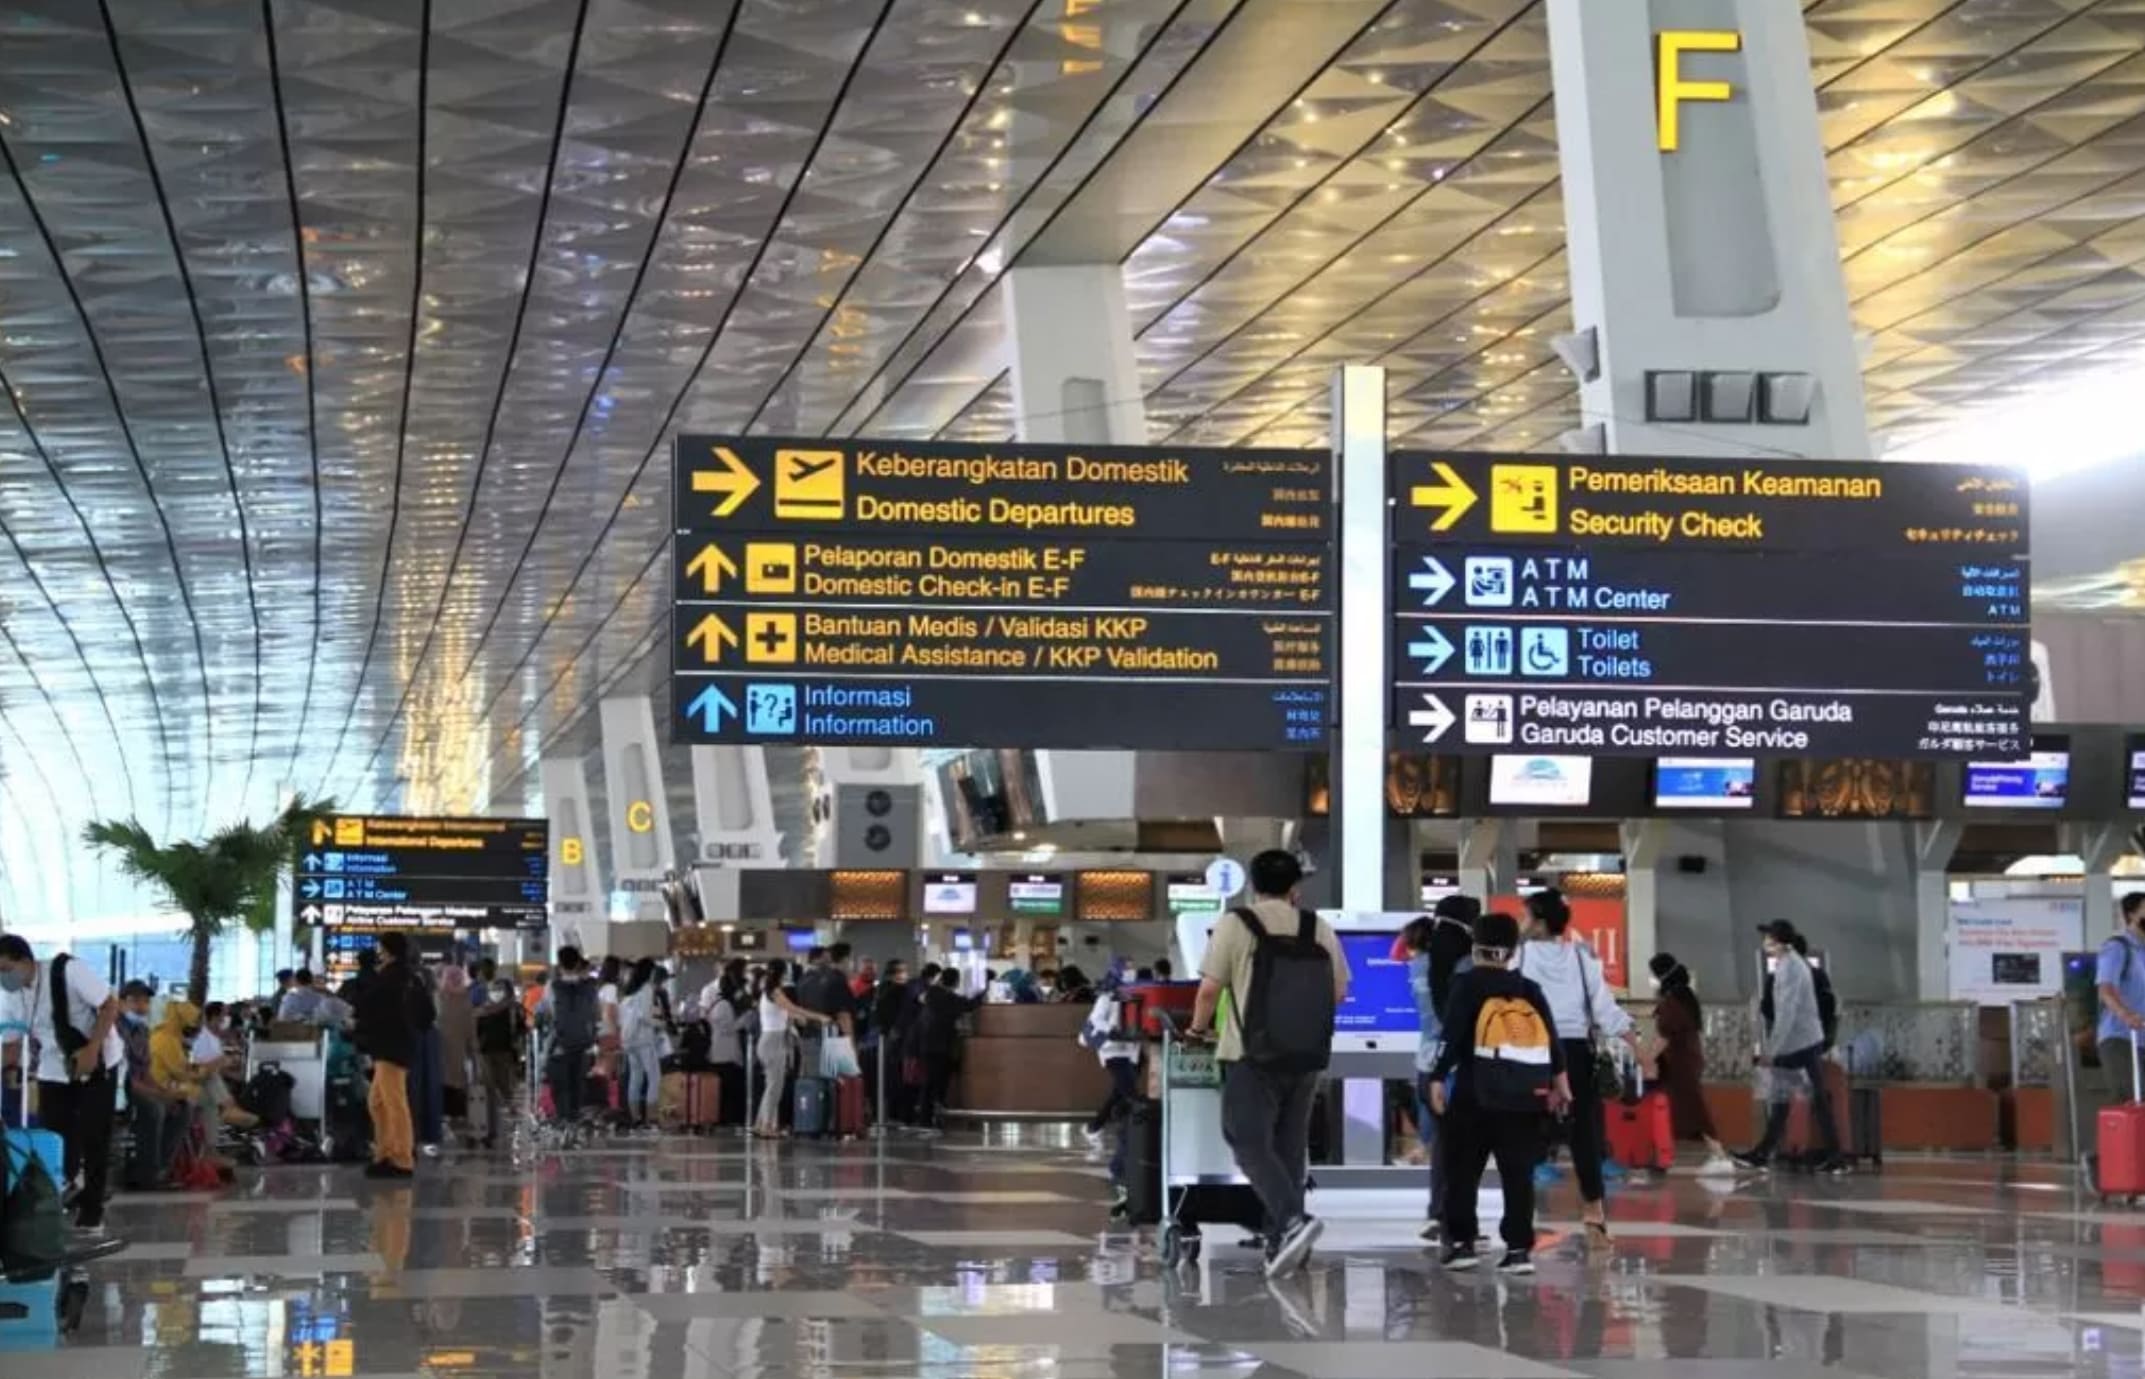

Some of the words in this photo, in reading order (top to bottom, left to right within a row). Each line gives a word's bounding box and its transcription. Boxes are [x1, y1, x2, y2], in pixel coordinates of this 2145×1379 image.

[1656, 30, 1741, 153] F
[856, 451, 1058, 485] Keberangkatan
[1066, 456, 1189, 483] Domestik
[1569, 465, 1736, 495] Pemeriksaan
[1742, 470, 1882, 498] Keamanan
[856, 495, 982, 523] Domestic
[991, 498, 1136, 529] Departures
[1569, 508, 1675, 542] Security
[1680, 511, 1763, 538] Check
[803, 543, 922, 575] Pelaporan
[929, 545, 1037, 571] Domestik
[1043, 548, 1085, 571] E-F
[803, 571, 913, 596] Domestic
[918, 574, 1021, 598] Check-in
[1027, 576, 1070, 599] E-F
[1593, 586, 1671, 610] Center
[804, 613, 902, 637] Bantuan
[908, 615, 978, 638] Medis
[983, 615, 996, 638] /
[998, 616, 1089, 639] Validasi
[1094, 617, 1148, 639] KKP
[1577, 627, 1639, 650] Toilet
[804, 641, 894, 665] Medical
[900, 643, 1027, 667] Assistance
[1033, 645, 1044, 668] /
[1049, 646, 1102, 667] KKP
[1105, 646, 1218, 669] Validation
[1577, 654, 1652, 678] Toilets
[805, 685, 912, 708] Informasi
[804, 712, 934, 736] Information
[1520, 694, 1638, 725] Pelayanan
[1644, 696, 1764, 728] Pelanggan
[1769, 698, 1853, 723] Garuda
[1520, 722, 1605, 746] Garuda
[1610, 722, 1720, 748] Customer
[1724, 724, 1809, 749] Service
[627, 801, 653, 832] C
[561, 837, 583, 865] B
